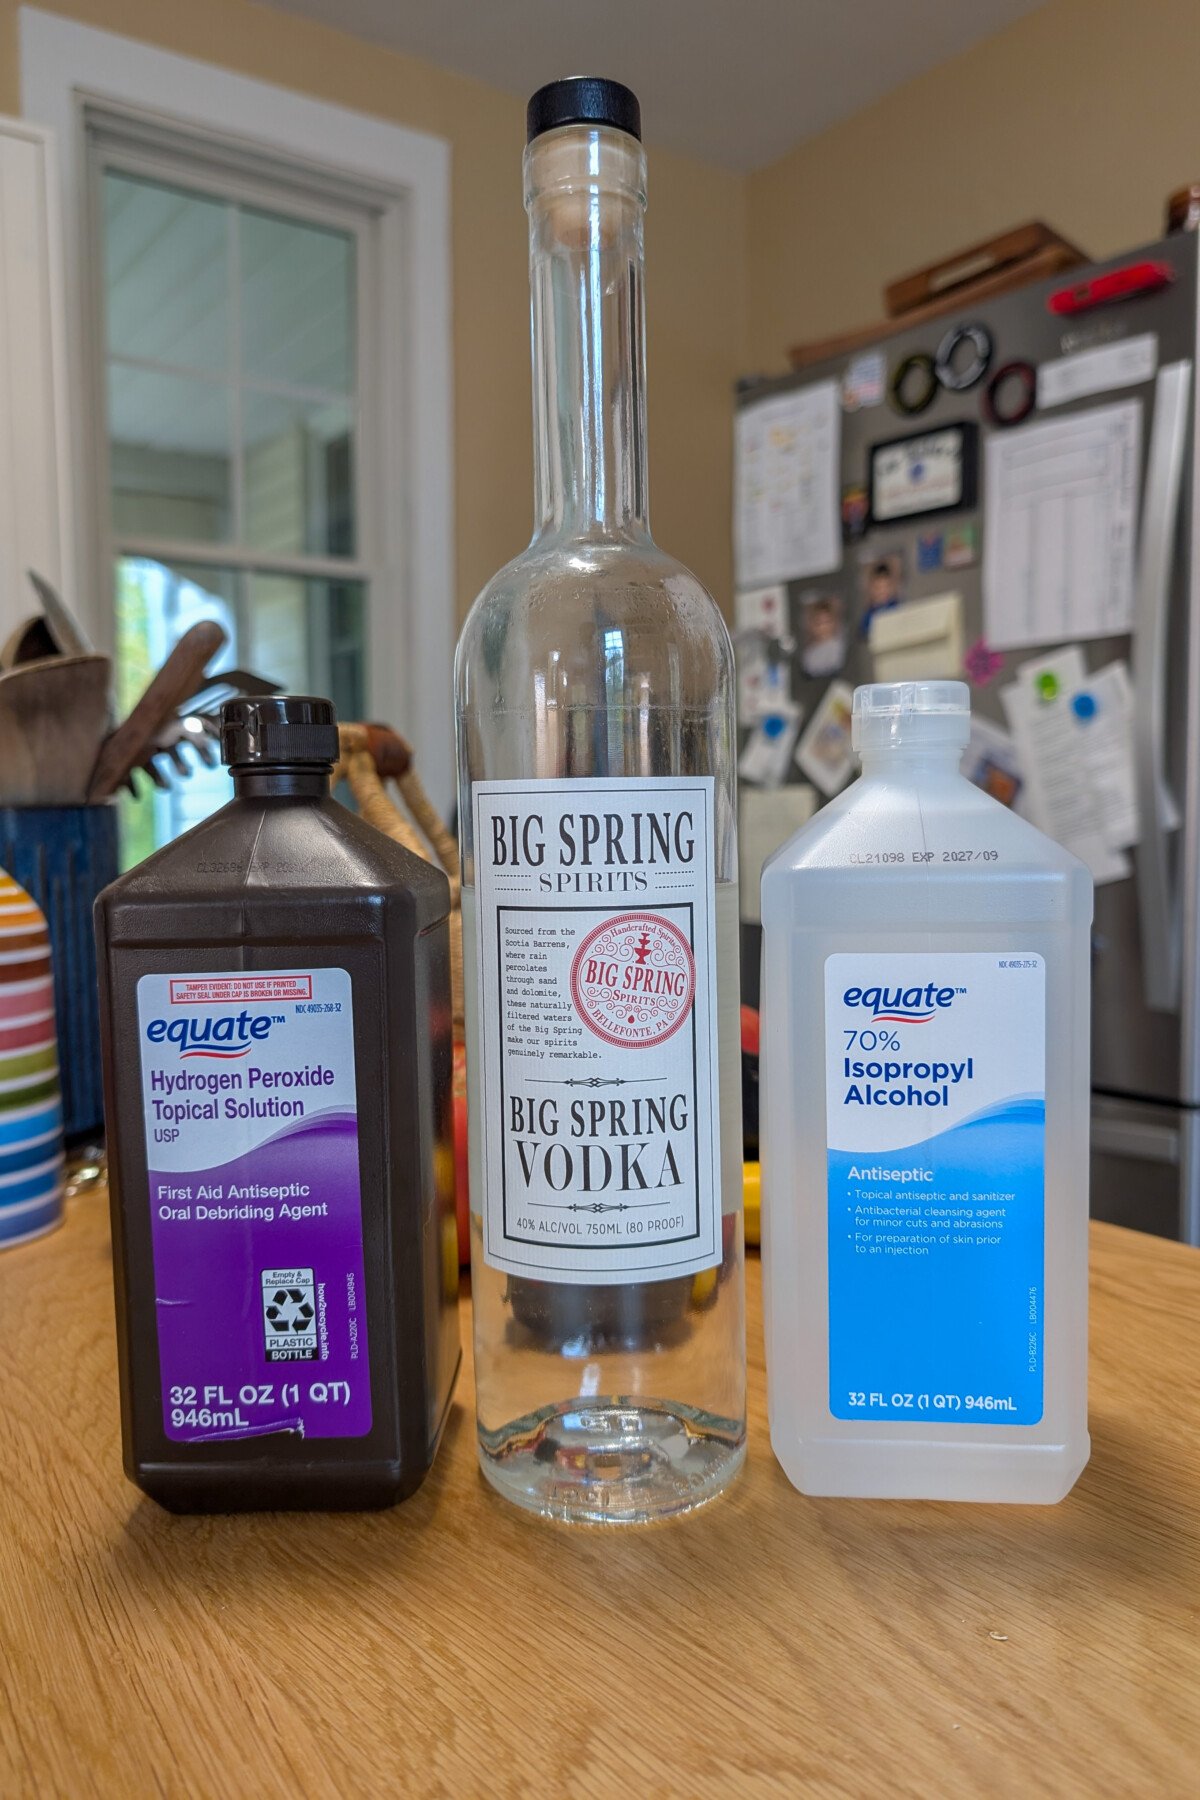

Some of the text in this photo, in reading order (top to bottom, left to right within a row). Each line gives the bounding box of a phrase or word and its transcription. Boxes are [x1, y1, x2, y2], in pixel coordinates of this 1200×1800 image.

[491, 811, 695, 867] BIG SPRING
[850, 850, 999, 864] CL21098 EXP 2027/09
[539, 871, 648, 893] SPIRITS
[505, 927, 576, 936] Sourced from the
[610, 922, 676, 947] Handcrafted Spirits
[505, 939, 570, 949] Scotia Barrens,
[505, 951, 547, 960] where rain
[505, 964, 548, 972] percolates
[506, 976, 557, 985] through sand
[584, 959, 685, 997] BIG SPRING
[185, 983, 208, 991] TAMPER
[233, 982, 241, 990] DO
[273, 980, 296, 988] PRINTED
[176, 992, 196, 1000] SAFETY
[212, 991, 230, 999] UNDER
[231, 990, 243, 998] CAP
[273, 989, 282, 997] OR
[283, 988, 308, 996] MISSING.
[521, 989, 561, 998] dolomite,
[530, 1002, 572, 1011] naturally
[507, 1011, 572, 1022] filtered waters
[535, 1025, 549, 1035] Big
[553, 1026, 583, 1035] Spring
[655, 1019, 669, 1031] PA
[507, 1036, 523, 1044] make
[544, 1038, 578, 1047] spirits
[843, 1030, 901, 1052] 70%
[507, 1048, 602, 1059] genuinely remarkable.
[844, 1057, 974, 1084] Isopropyl
[150, 1065, 335, 1095] Hydrogen Peroxide
[843, 1084, 949, 1106] Alcohol
[152, 1096, 304, 1124] Topical Solution
[509, 1094, 689, 1138] BIG SPRING
[154, 1128, 180, 1143] USP
[512, 1139, 686, 1192] VODKA
[847, 1166, 934, 1184] Antiseptic
[157, 1182, 310, 1201] First Aid Antiseptic
[854, 1189, 1016, 1202] Topical antiseptic and sanitizer
[158, 1202, 328, 1222] Oral Debriding Agent
[854, 1205, 1006, 1220] Antibacterial cleansing agent
[516, 1215, 684, 1235] 40% ALC/VOL 750ML (80 PROOF)
[855, 1216, 1004, 1229] for minor cuts and abrasions
[854, 1232, 1001, 1246] For preparation of skin prior
[855, 1245, 929, 1256] to an injection
[265, 1278, 294, 1286] Replace
[272, 1271, 295, 1279] Empty
[1029, 1286, 1038, 1324] LB004476
[317, 1282, 330, 1361] how2recycle.info
[269, 1337, 314, 1348] PLASTIC
[271, 1349, 313, 1360] BOTTLE
[170, 1381, 350, 1408] 32 FL OZ (1 QT)
[848, 1392, 1017, 1411] 32 FL OZ (1 QT) 946mL
[171, 1407, 250, 1427] 946mL
